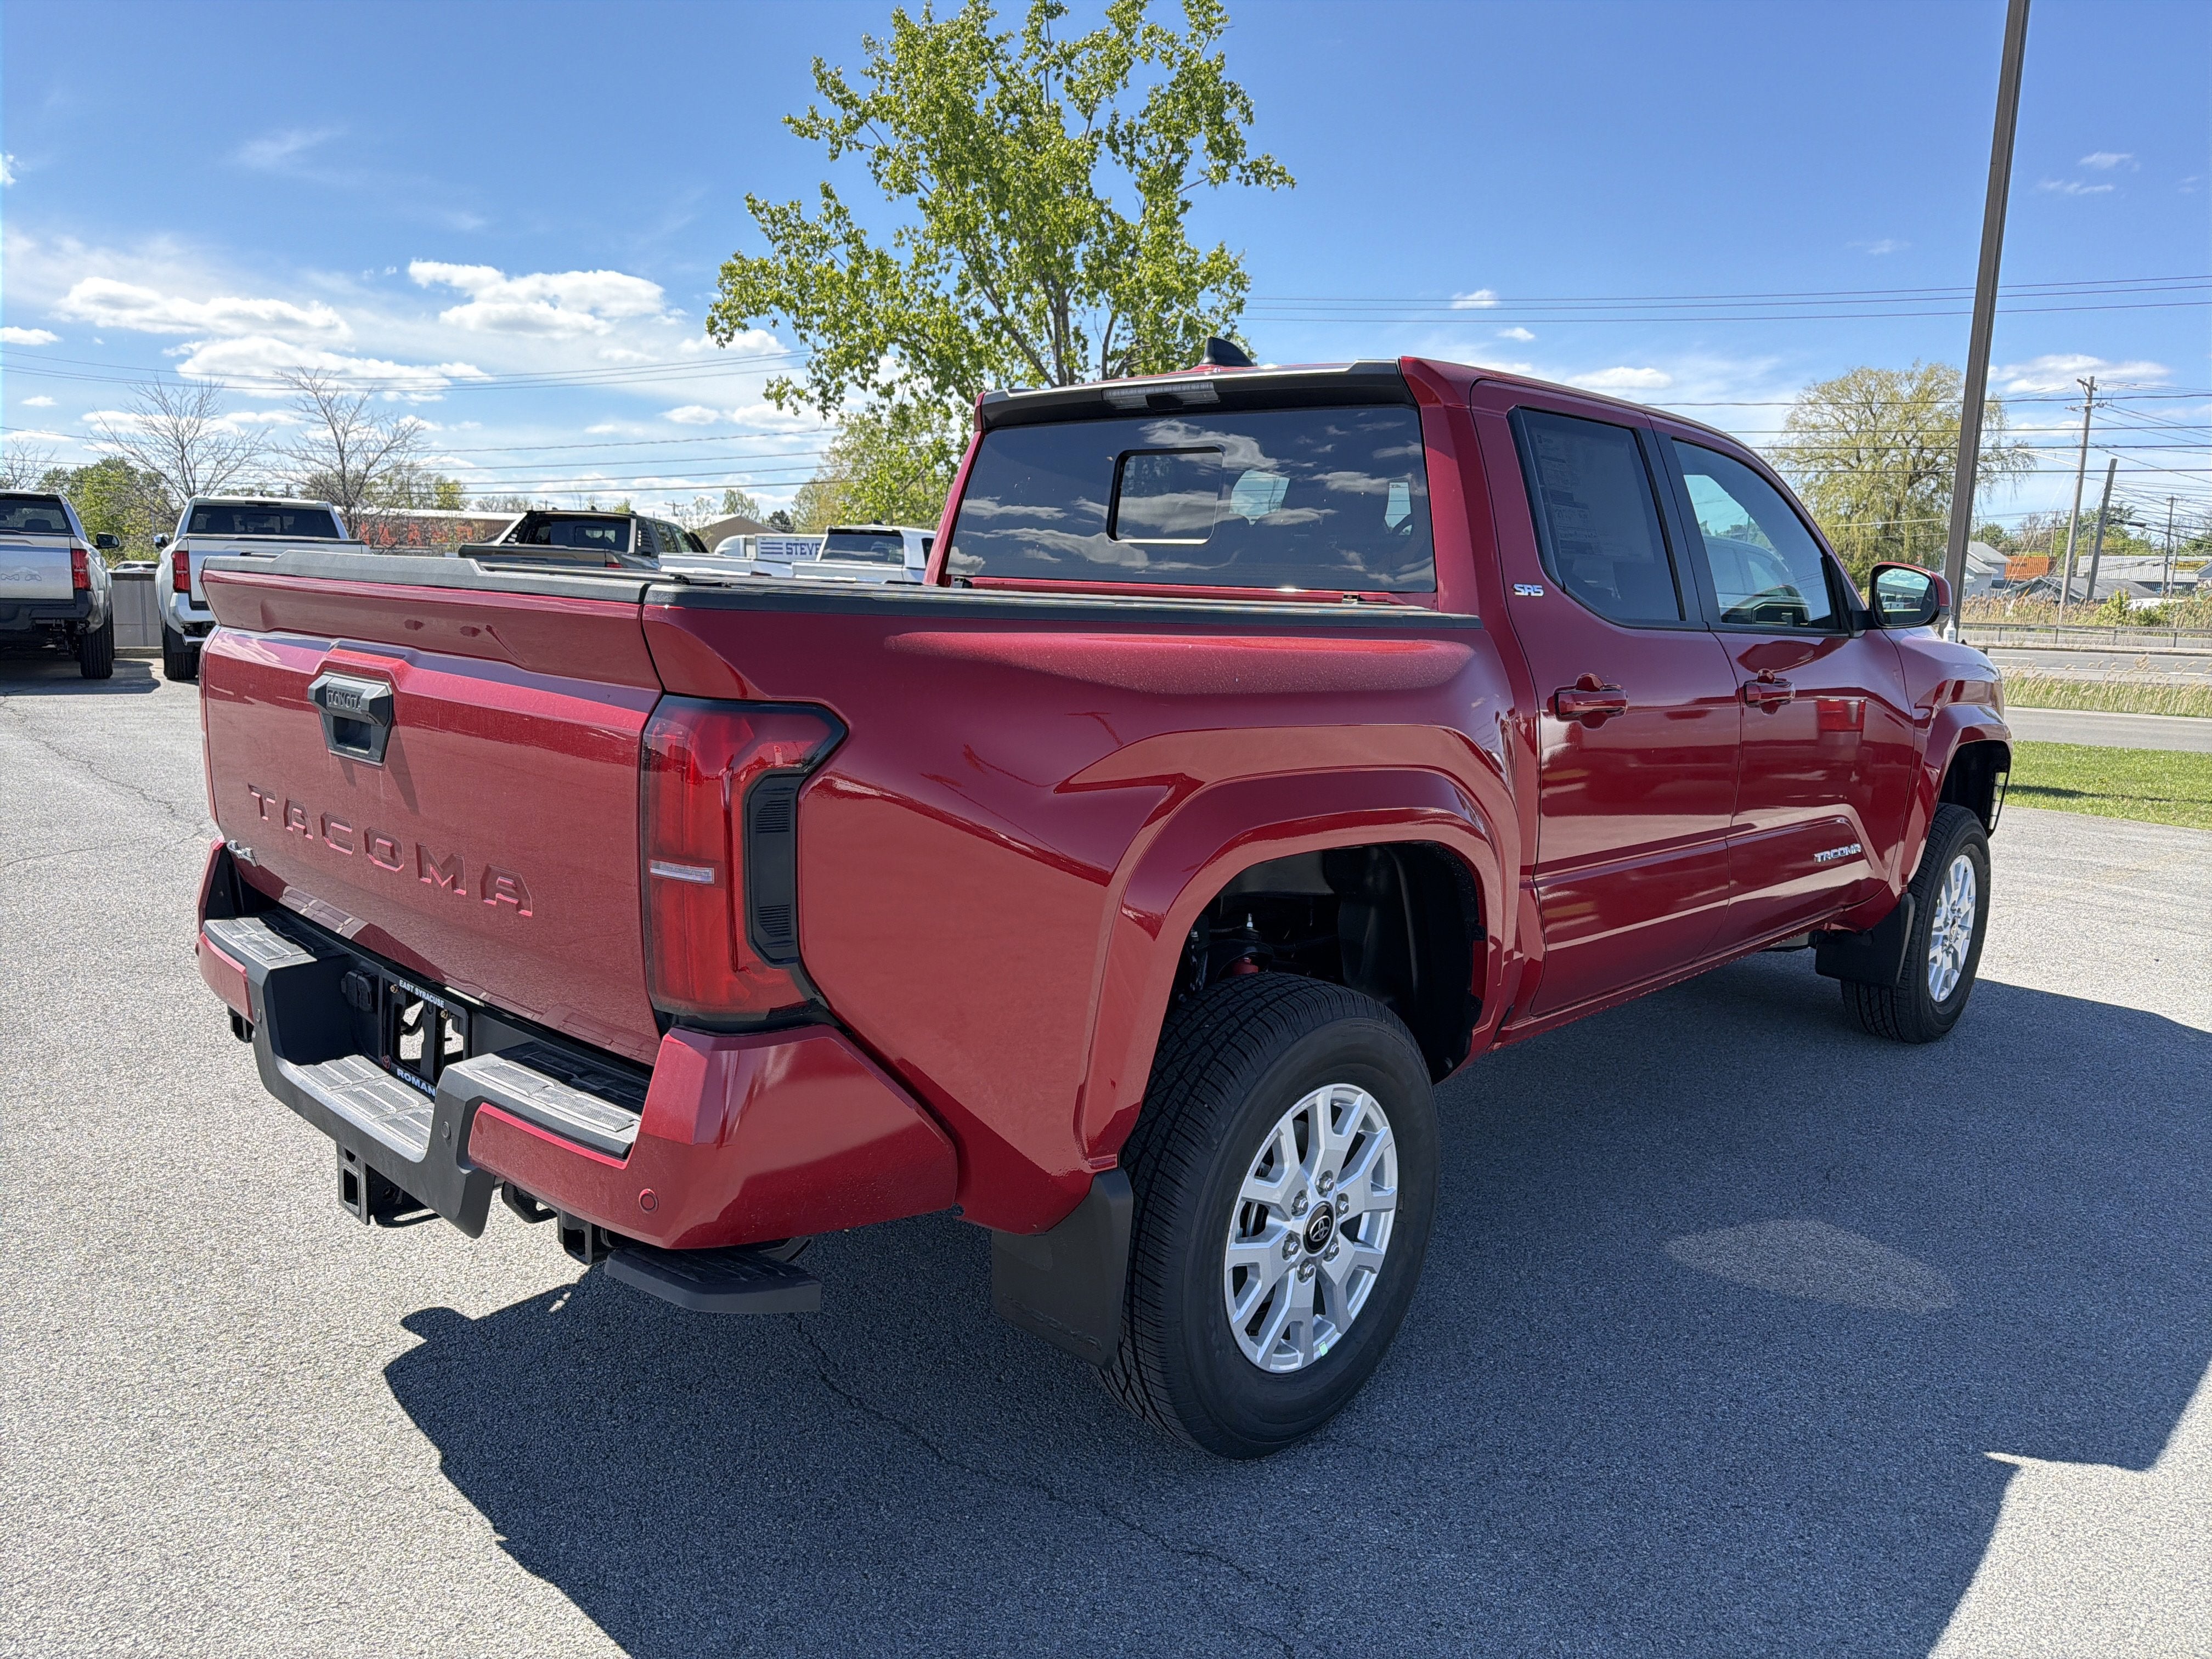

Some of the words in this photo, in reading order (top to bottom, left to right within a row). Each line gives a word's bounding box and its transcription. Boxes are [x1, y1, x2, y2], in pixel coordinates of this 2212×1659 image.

[1513, 584, 1544, 596] SR5
[247, 783, 533, 917] TACOMA
[1814, 843, 1861, 862] TACOMA
[399, 979, 414, 993] EAST
[415, 987, 445, 1008] SYRACUSE
[397, 1067, 436, 1097] ROMAN
